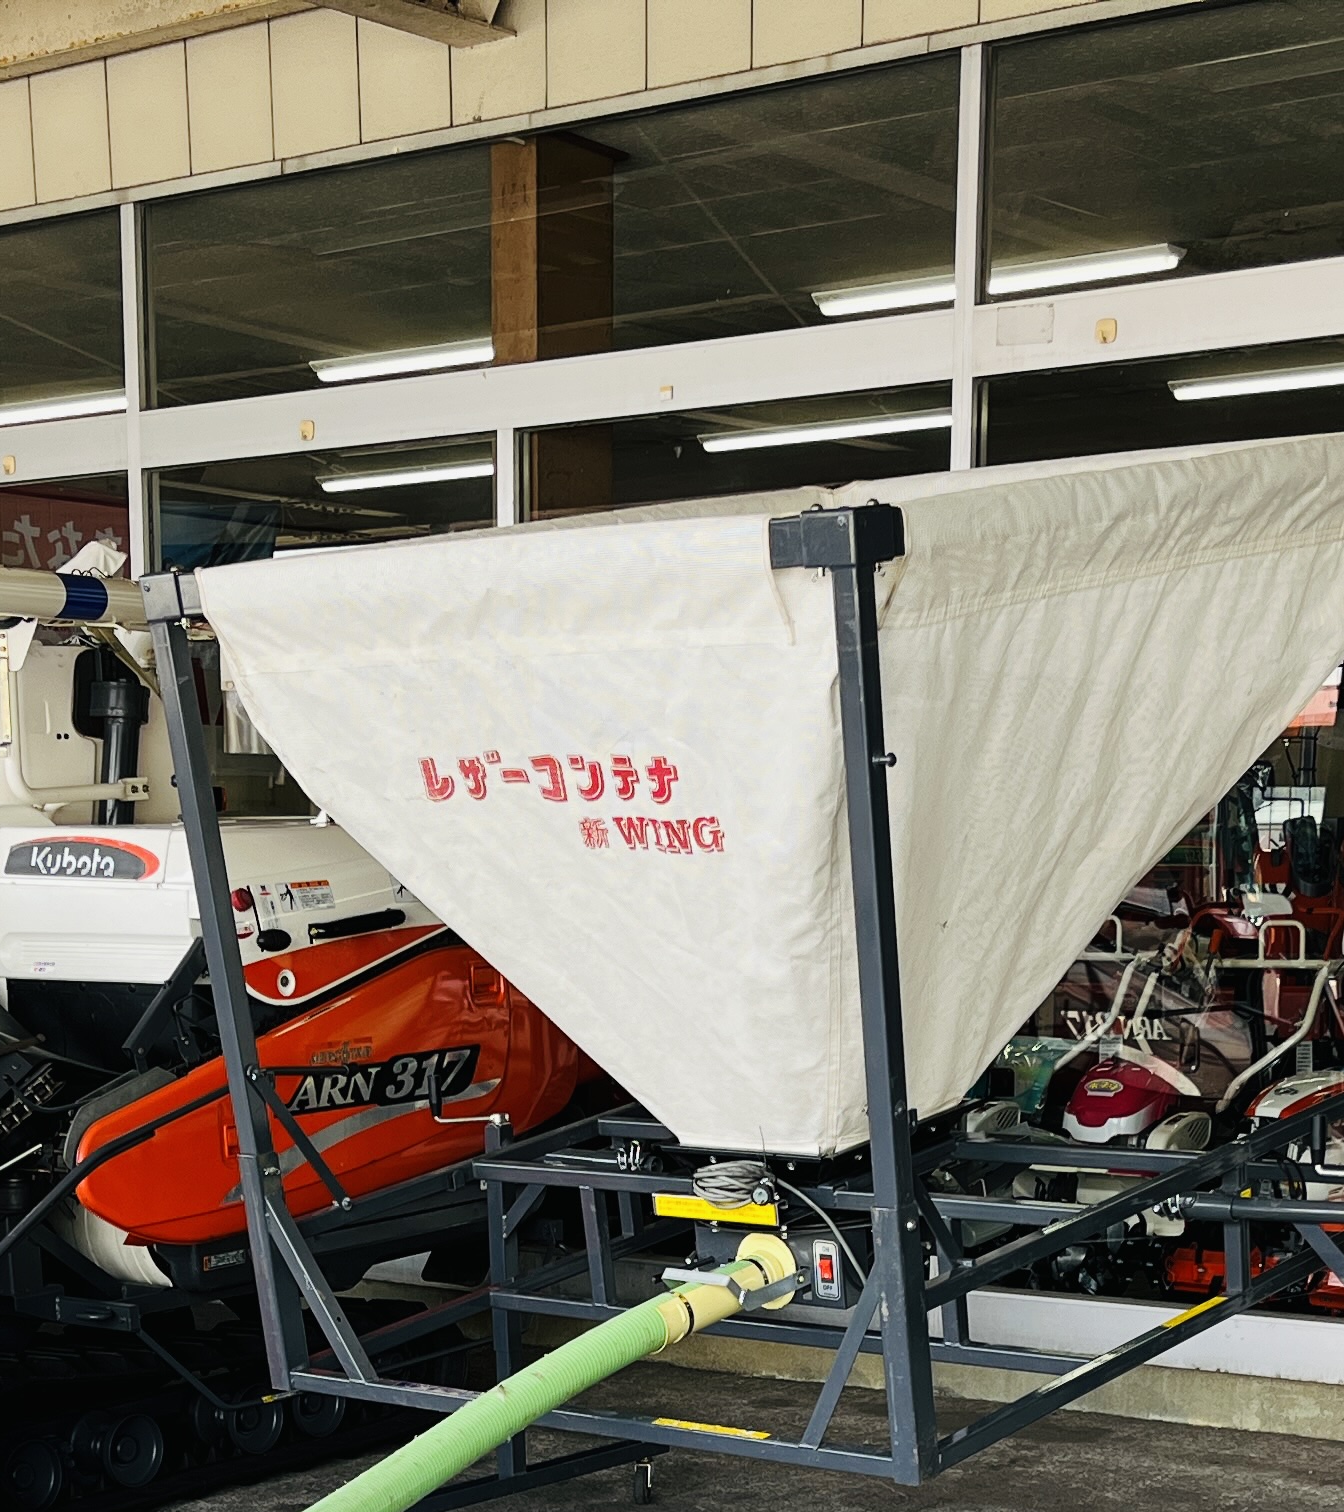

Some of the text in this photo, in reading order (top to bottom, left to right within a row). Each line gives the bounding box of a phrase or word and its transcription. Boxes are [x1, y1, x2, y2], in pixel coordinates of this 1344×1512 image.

[418, 750, 680, 804] レザーコンテナ
[578, 815, 726, 855] 新 WING
[30, 846, 115, 877] Kubota
[287, 1066, 382, 1111] ARN
[385, 1048, 472, 1099] 317
